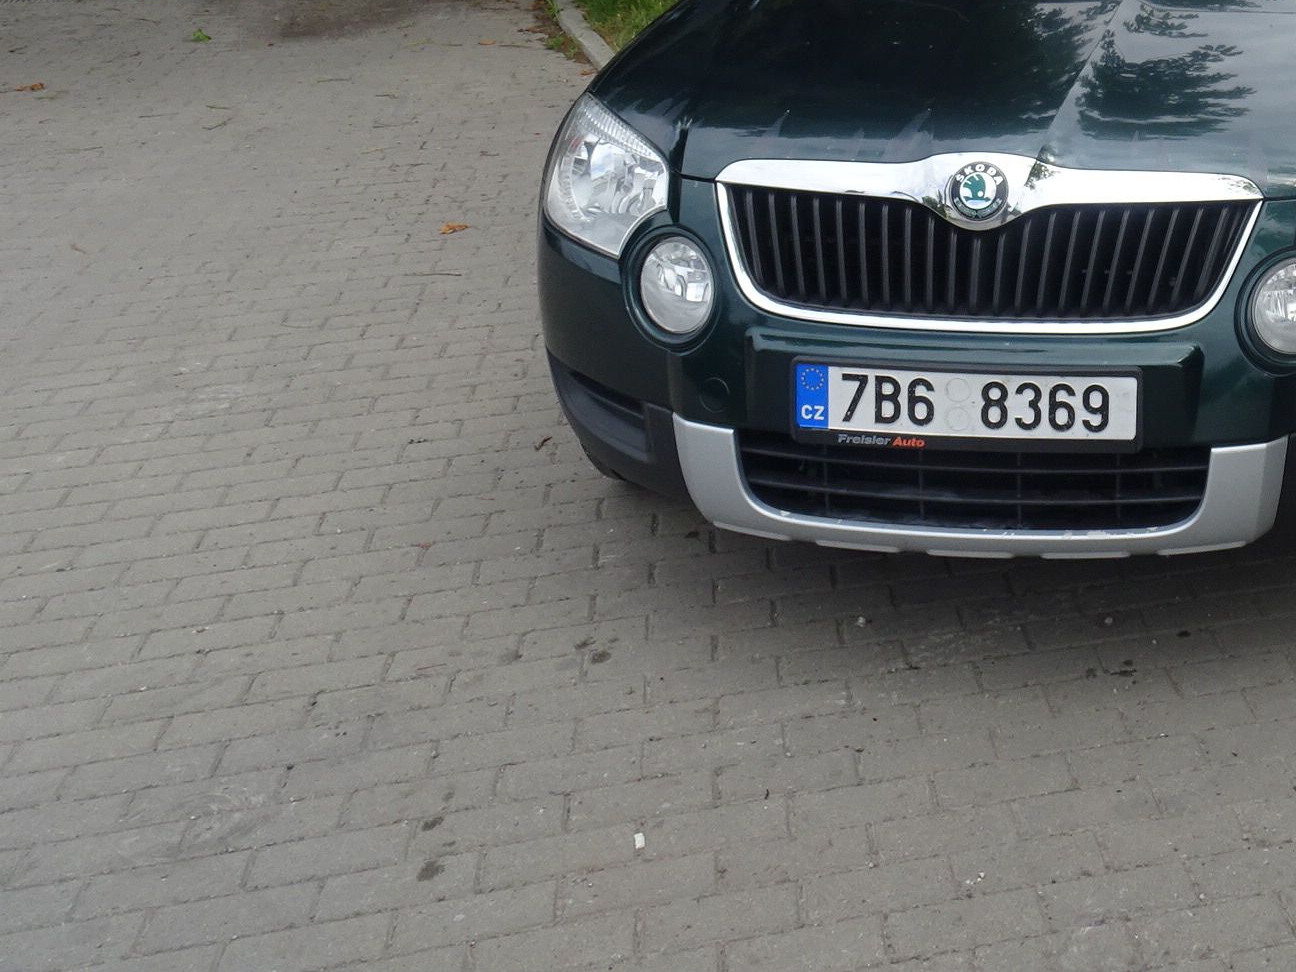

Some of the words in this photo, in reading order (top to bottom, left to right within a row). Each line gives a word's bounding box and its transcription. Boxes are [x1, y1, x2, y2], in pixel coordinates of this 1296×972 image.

[801, 405, 825, 421] CZ
[841, 373, 935, 426] 7B6
[981, 381, 1110, 433] 8369
[892, 436, 926, 448] Auto
